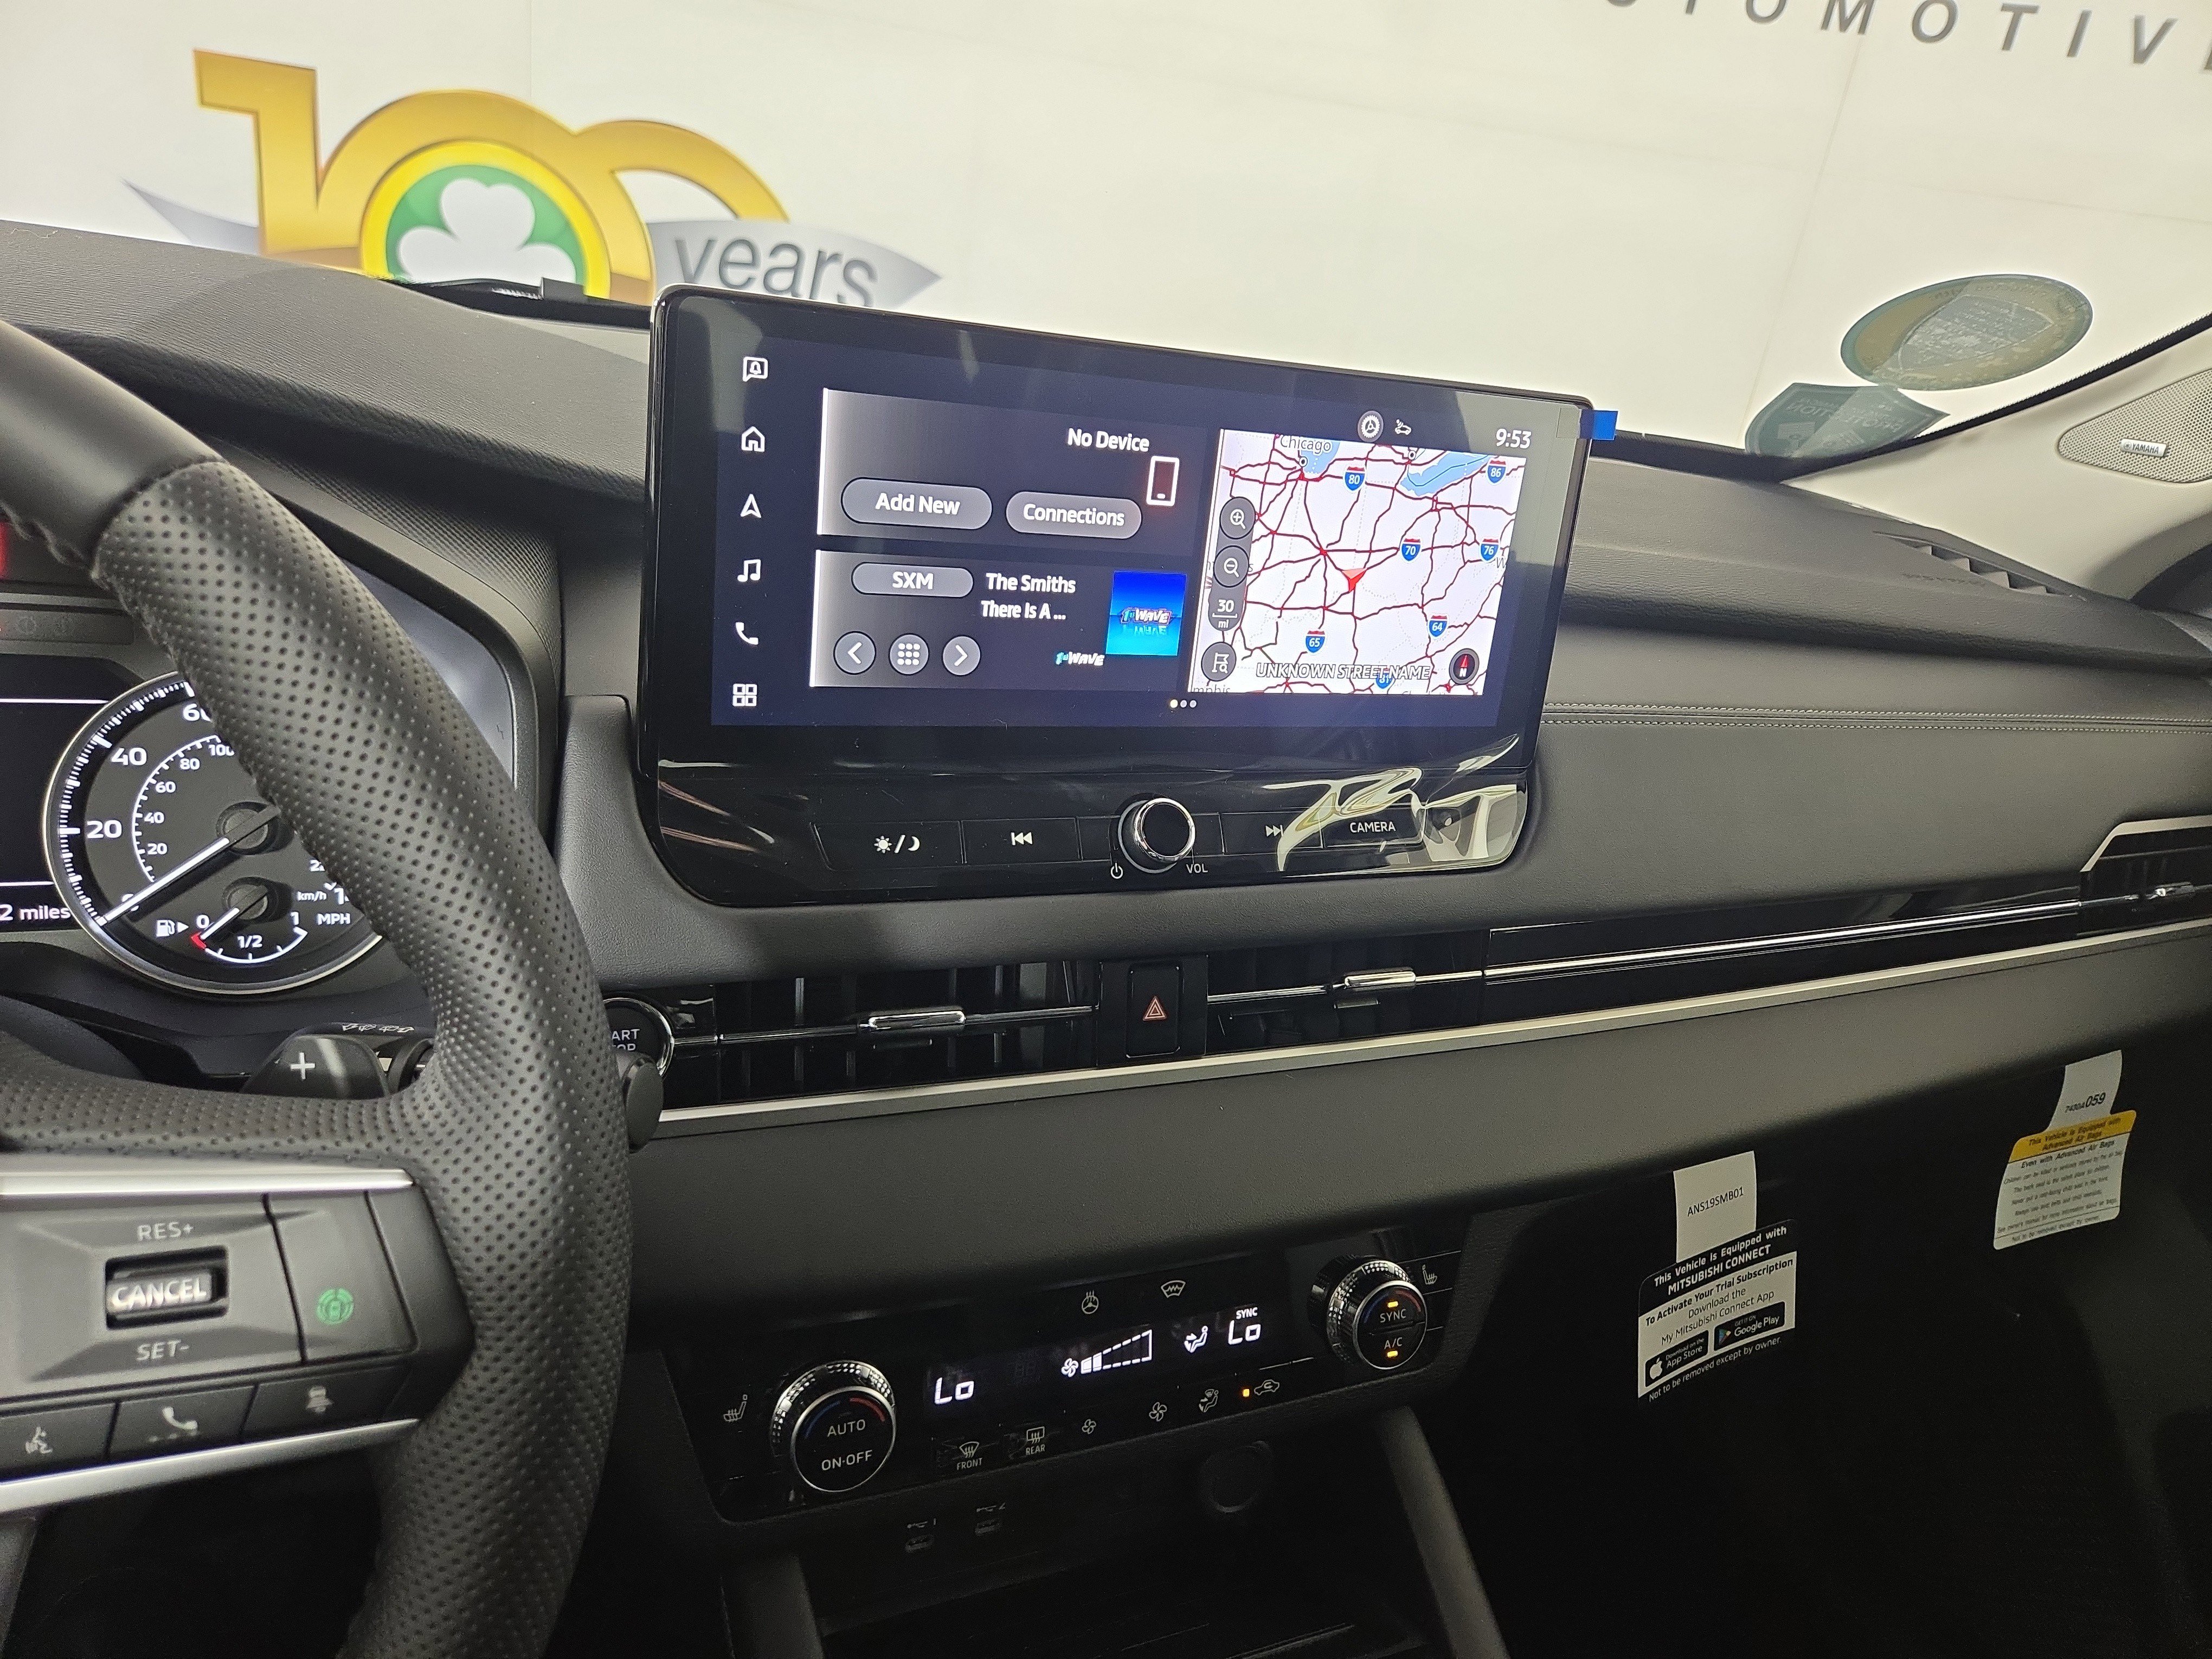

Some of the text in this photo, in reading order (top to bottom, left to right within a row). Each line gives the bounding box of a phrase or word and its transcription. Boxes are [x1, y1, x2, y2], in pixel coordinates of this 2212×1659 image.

[1067, 428, 1150, 452] No Device
[1281, 435, 1331, 454] Chicago
[1496, 428, 1532, 449] 9:53
[2132, 442, 2159, 454] YAMAHA
[1348, 474, 1361, 485] 80
[1490, 467, 1502, 478] 86
[876, 493, 961, 516] Add New
[1023, 503, 1126, 527] Connections
[1405, 545, 1416, 556] 70
[1484, 546, 1494, 556] 76
[892, 571, 935, 590] SXM
[986, 572, 1077, 594] The Smiths
[981, 600, 1021, 619] There
[1024, 602, 1037, 620] Is
[1037, 602, 1051, 620] A
[1217, 599, 1234, 613] 30
[1218, 619, 1229, 629] mi
[1431, 622, 1443, 632] 64
[1309, 638, 1321, 648] 65
[1256, 662, 1433, 680] UNKNOWN STREET NAME
[111, 747, 147, 766] 40
[179, 758, 201, 770] 80
[155, 781, 177, 794] 60
[144, 812, 165, 824] 40
[86, 820, 123, 839] 20
[1349, 821, 1396, 833] CAMERA
[147, 843, 168, 856] 20
[1186, 864, 1208, 874] VOL
[298, 891, 327, 902] km/h
[20, 905, 71, 921] miles
[290, 911, 300, 925] 1
[317, 913, 351, 925] MPH
[196, 914, 210, 929] 0
[237, 935, 263, 949] 1/2
[612, 1028, 640, 1041] ART
[1687, 1186, 1744, 1217] ANS19SMB01
[137, 1221, 194, 1242] RES+
[1654, 1272, 1671, 1287] This
[1675, 1257, 1706, 1277] Vehicle
[1721, 1233, 1761, 1258] Equipped
[1765, 1225, 1787, 1239] with
[1668, 1244, 1771, 1296] MITSUBISHI CONNECT
[111, 1277, 208, 1310] CANCEL
[1645, 1258, 1793, 1327] To Activate Your Trial Subscription
[1688, 1287, 1746, 1319] Download the
[1236, 1307, 1258, 1320] SYNC
[1379, 1308, 1407, 1324] SYNC
[1661, 1290, 1774, 1346] My Mitsubishi Connect App
[1734, 1314, 1780, 1338] Google Play
[1384, 1336, 1403, 1350] A/C
[1667, 1345, 1703, 1369] App Store
[1649, 1390, 1662, 1403] Not
[1663, 1384, 1670, 1392] to
[1672, 1378, 1681, 1388] be
[1682, 1361, 1714, 1383] removed
[1716, 1350, 1742, 1366] except
[1743, 1345, 1753, 1355] by
[827, 1418, 866, 1437] AUTO
[1025, 1443, 1046, 1456] REAR
[956, 1457, 983, 1471] FRONT
